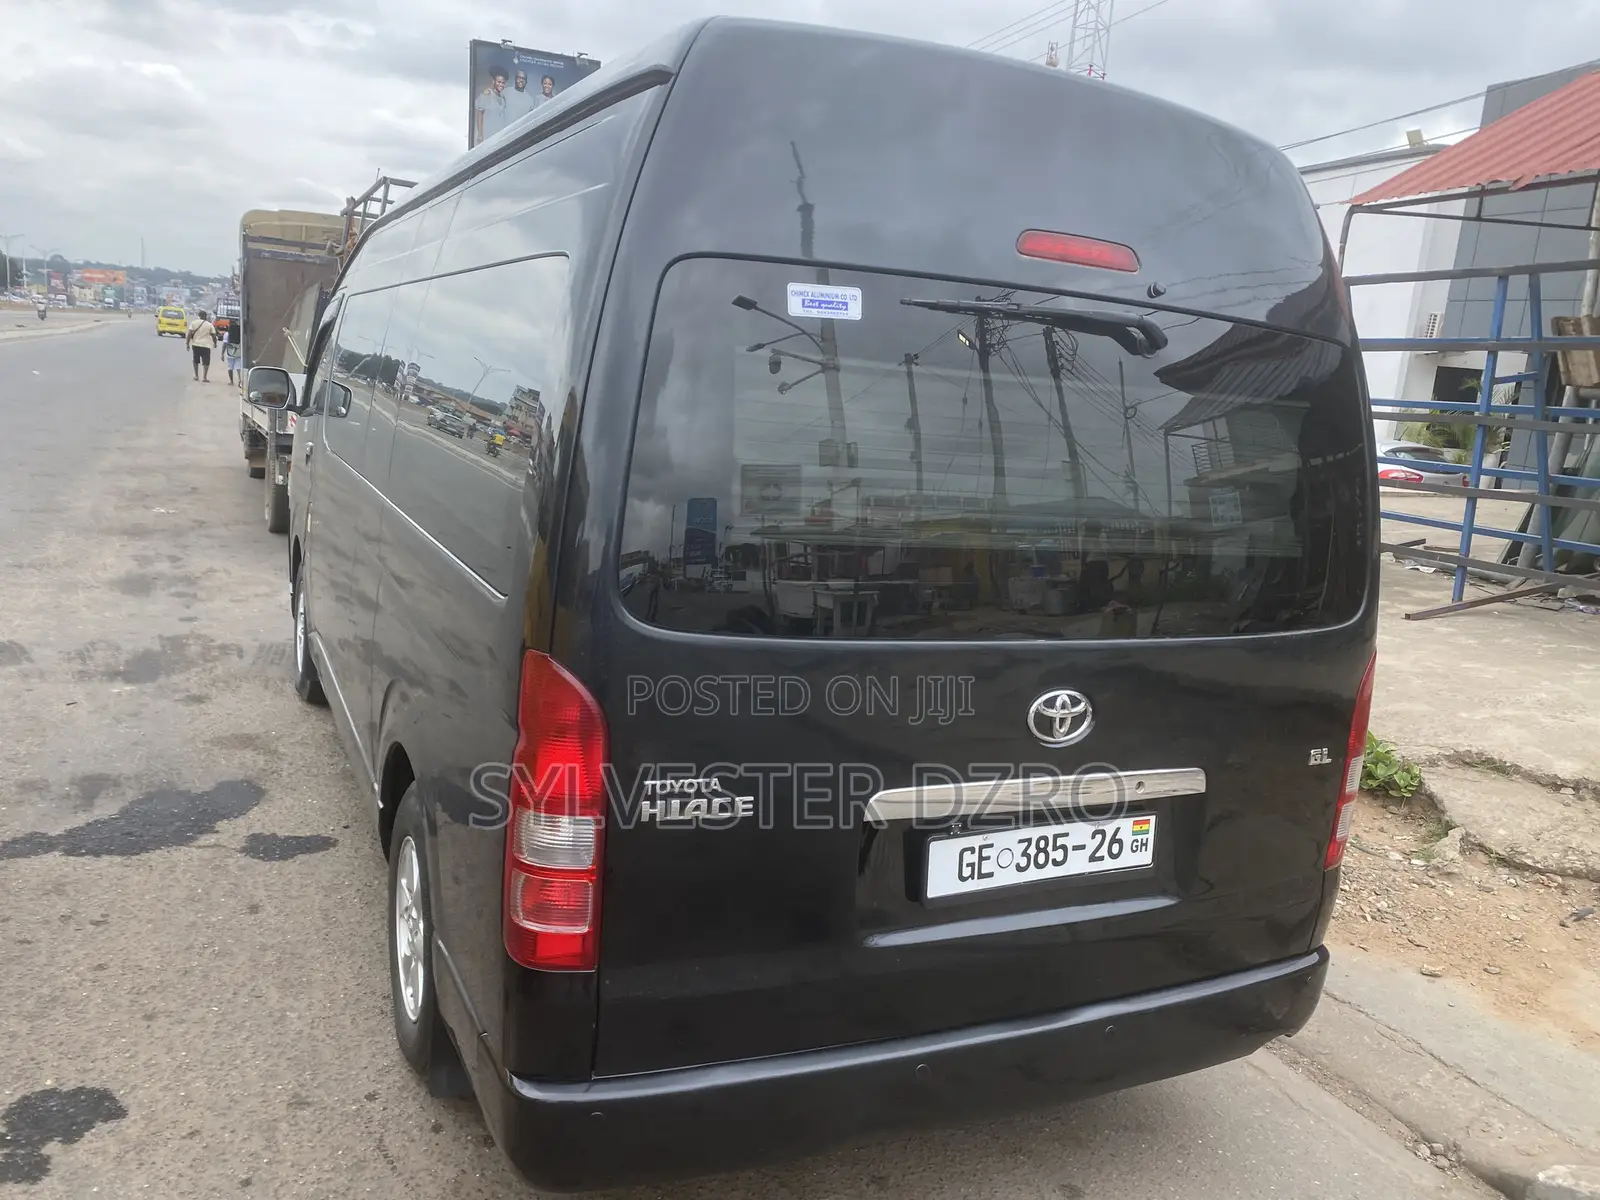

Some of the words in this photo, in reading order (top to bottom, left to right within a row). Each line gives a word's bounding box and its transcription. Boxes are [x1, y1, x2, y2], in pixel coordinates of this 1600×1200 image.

[643, 777, 722, 796] TOYOTA
[640, 796, 755, 822] HIACE
[957, 842, 995, 883] GE
[1015, 826, 1124, 873] 385-26
[1130, 838, 1149, 854] GH
